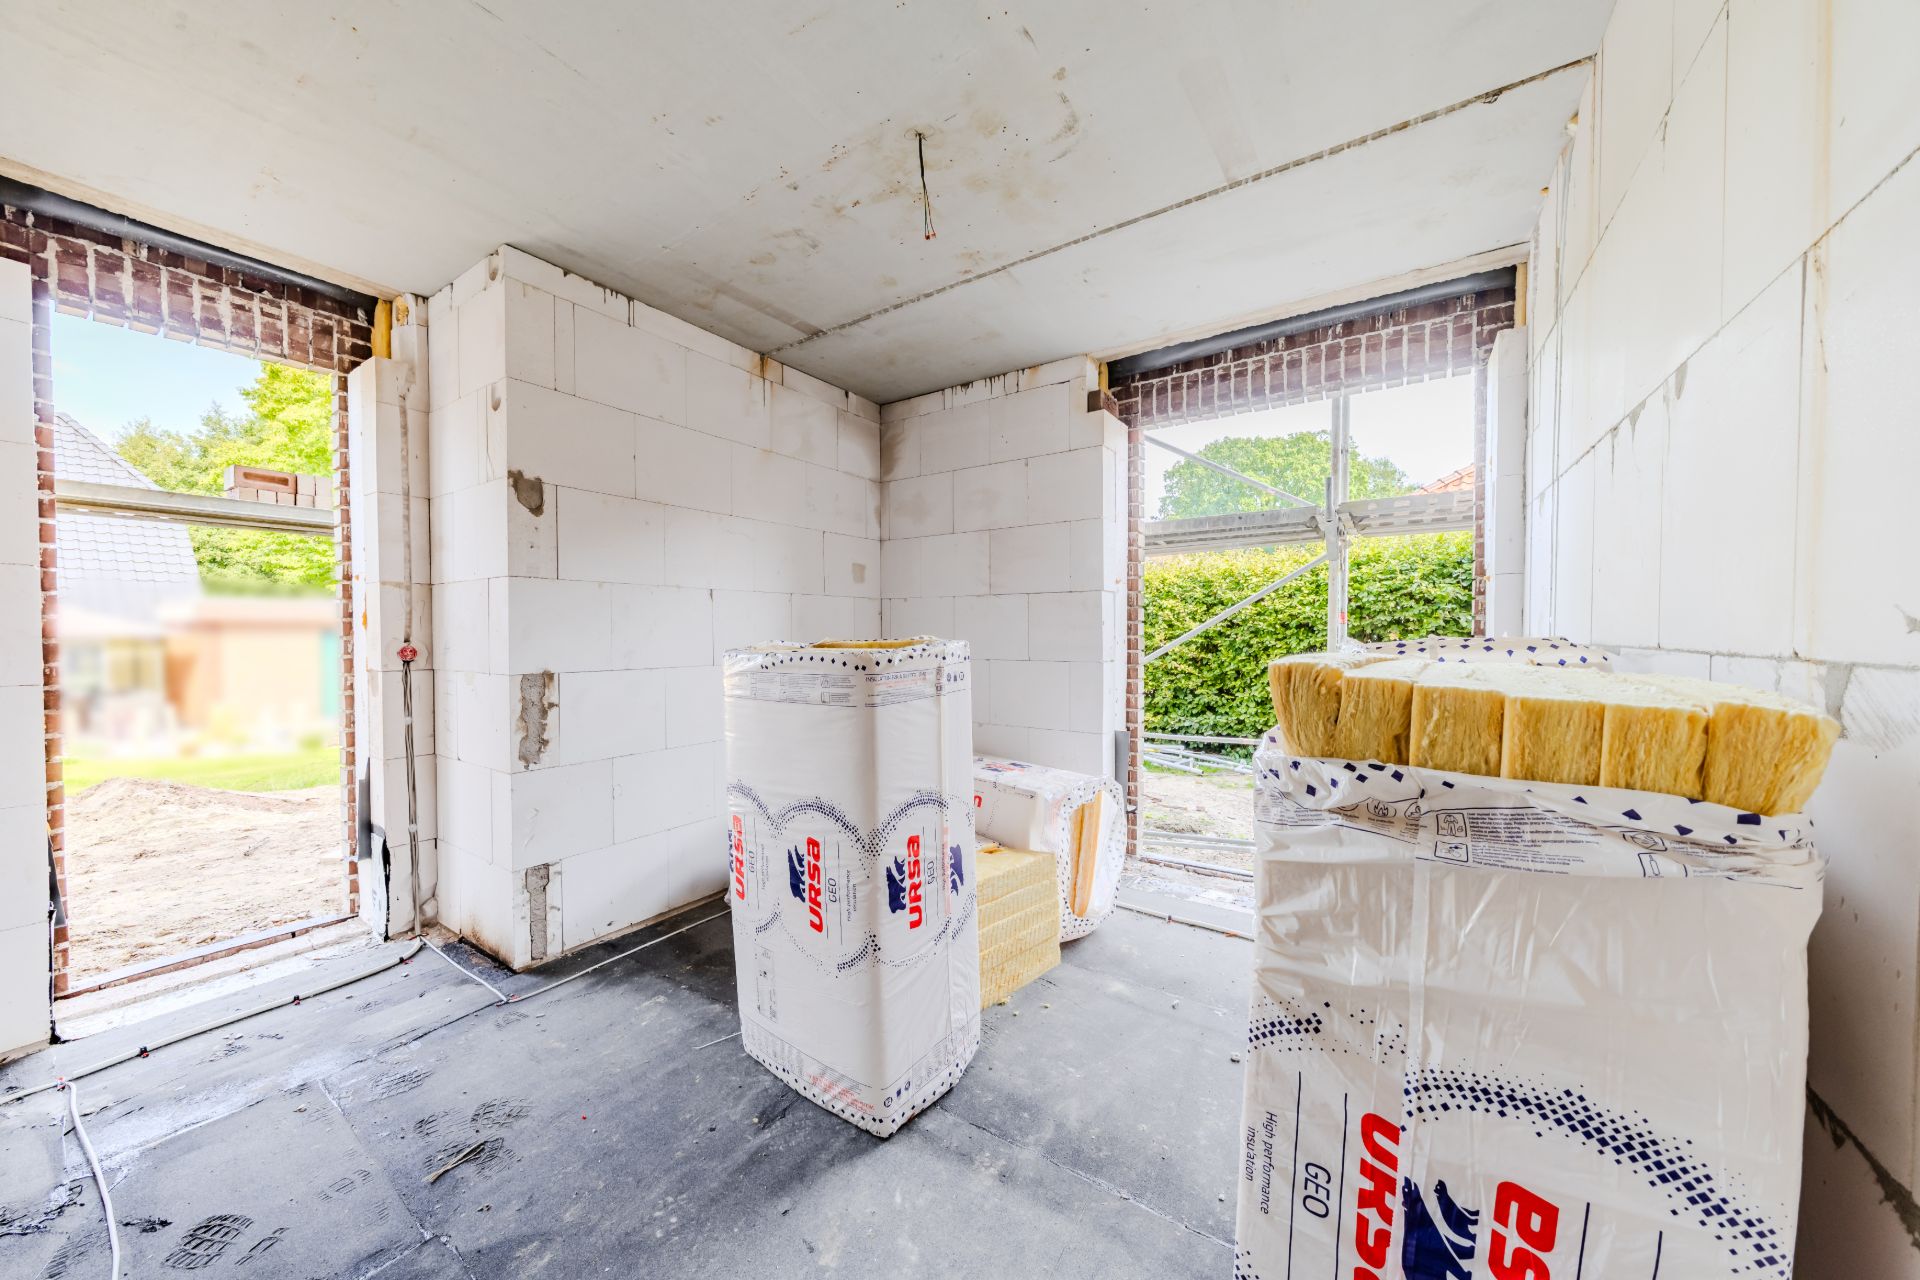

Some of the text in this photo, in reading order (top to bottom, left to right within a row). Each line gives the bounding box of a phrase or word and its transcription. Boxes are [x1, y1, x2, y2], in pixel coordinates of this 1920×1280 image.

[827, 877, 837, 903] GEO
[926, 860, 935, 885] GEO
[1260, 1110, 1278, 1215] High performance
[1302, 1161, 1332, 1219] GEO
